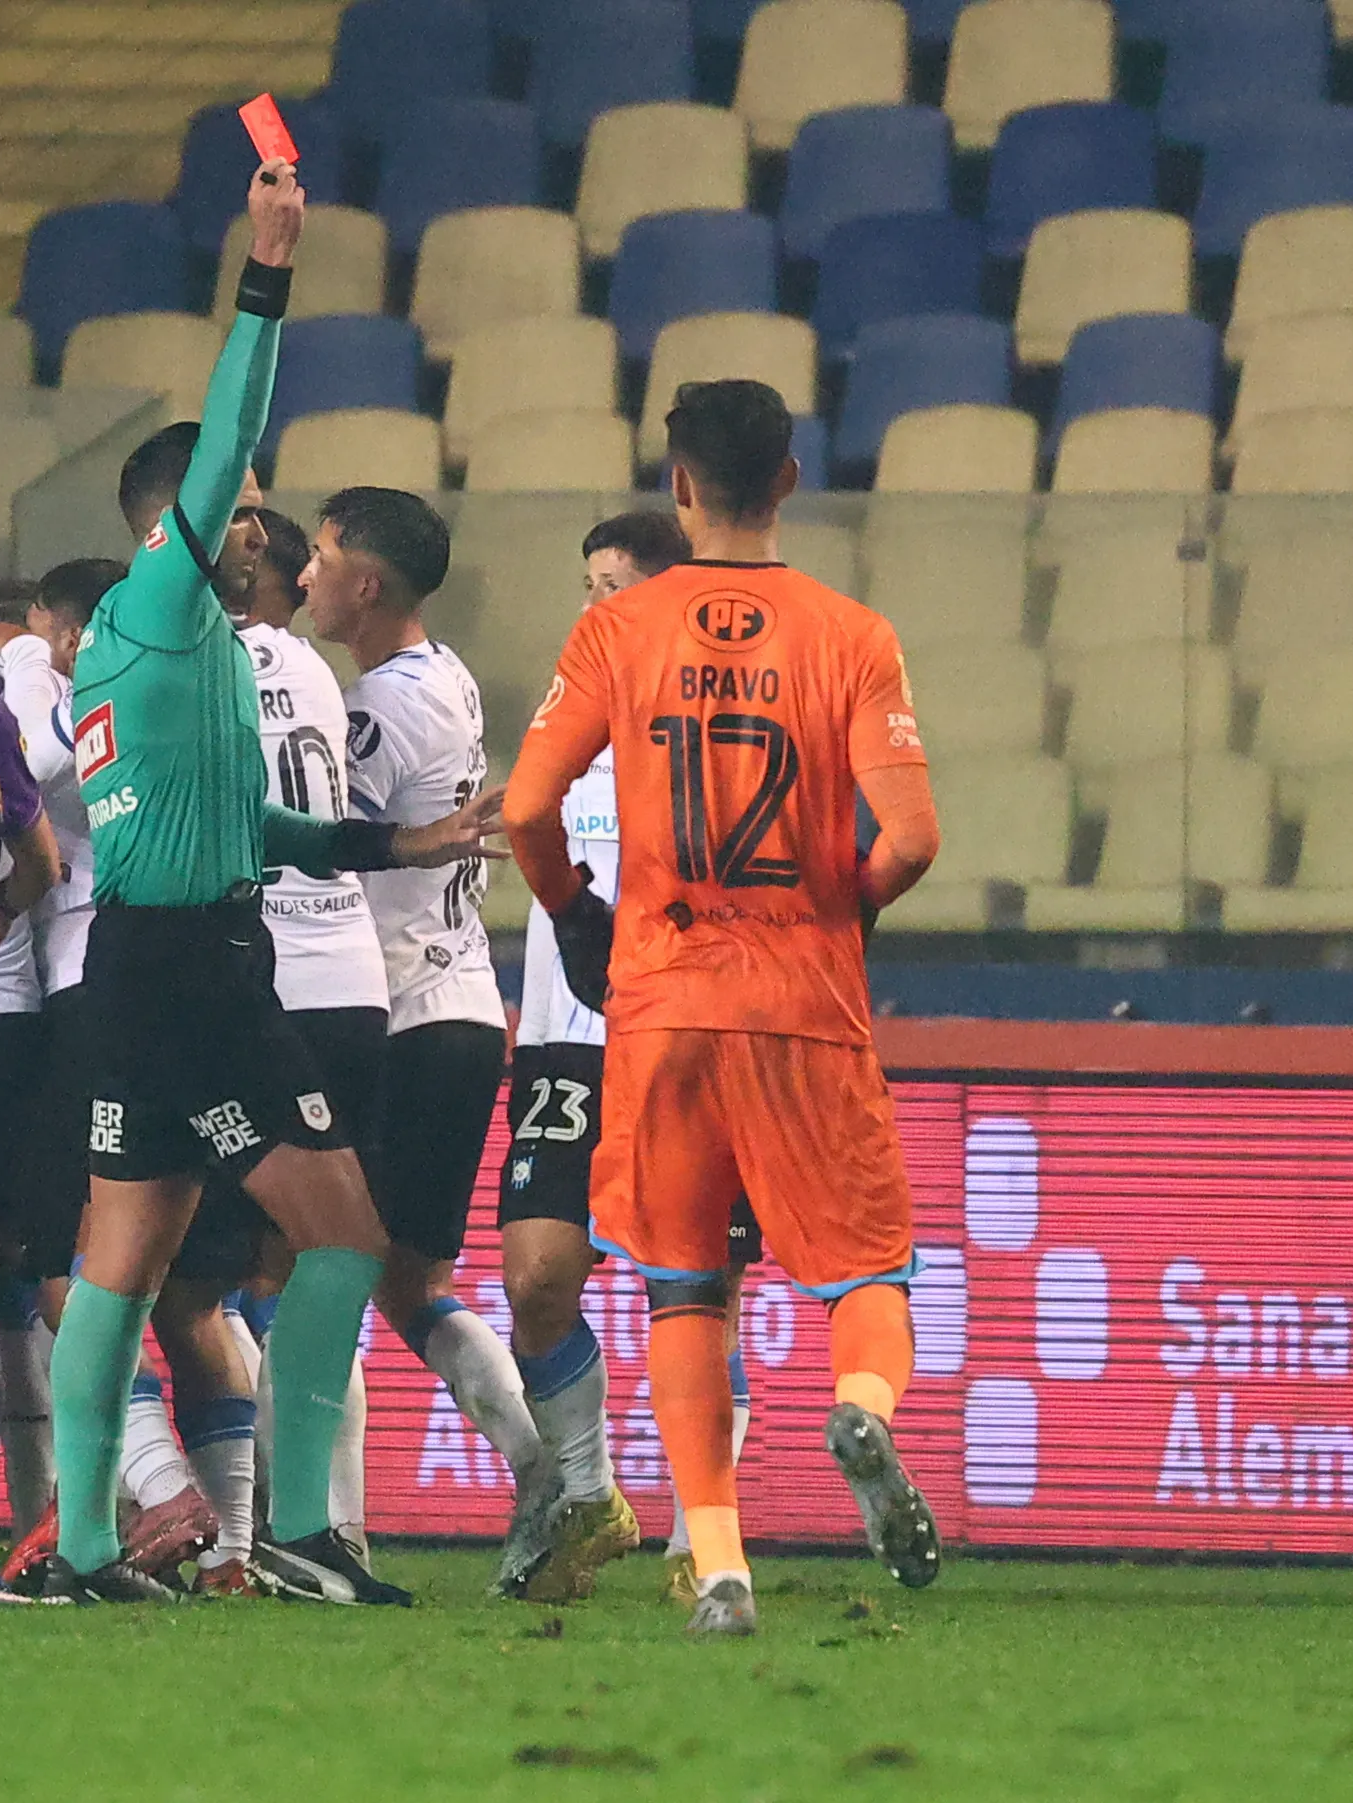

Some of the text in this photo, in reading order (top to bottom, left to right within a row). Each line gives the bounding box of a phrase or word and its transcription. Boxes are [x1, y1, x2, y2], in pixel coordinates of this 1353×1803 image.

[706, 600, 758, 641] PF
[679, 664, 780, 704] BRAVO
[76, 721, 109, 778] NCO
[87, 785, 139, 830] TURAS
[649, 712, 799, 889] 12
[515, 1076, 592, 1142] 23
[212, 1120, 263, 1160] ADE
[1158, 1256, 1353, 1380] Sana
